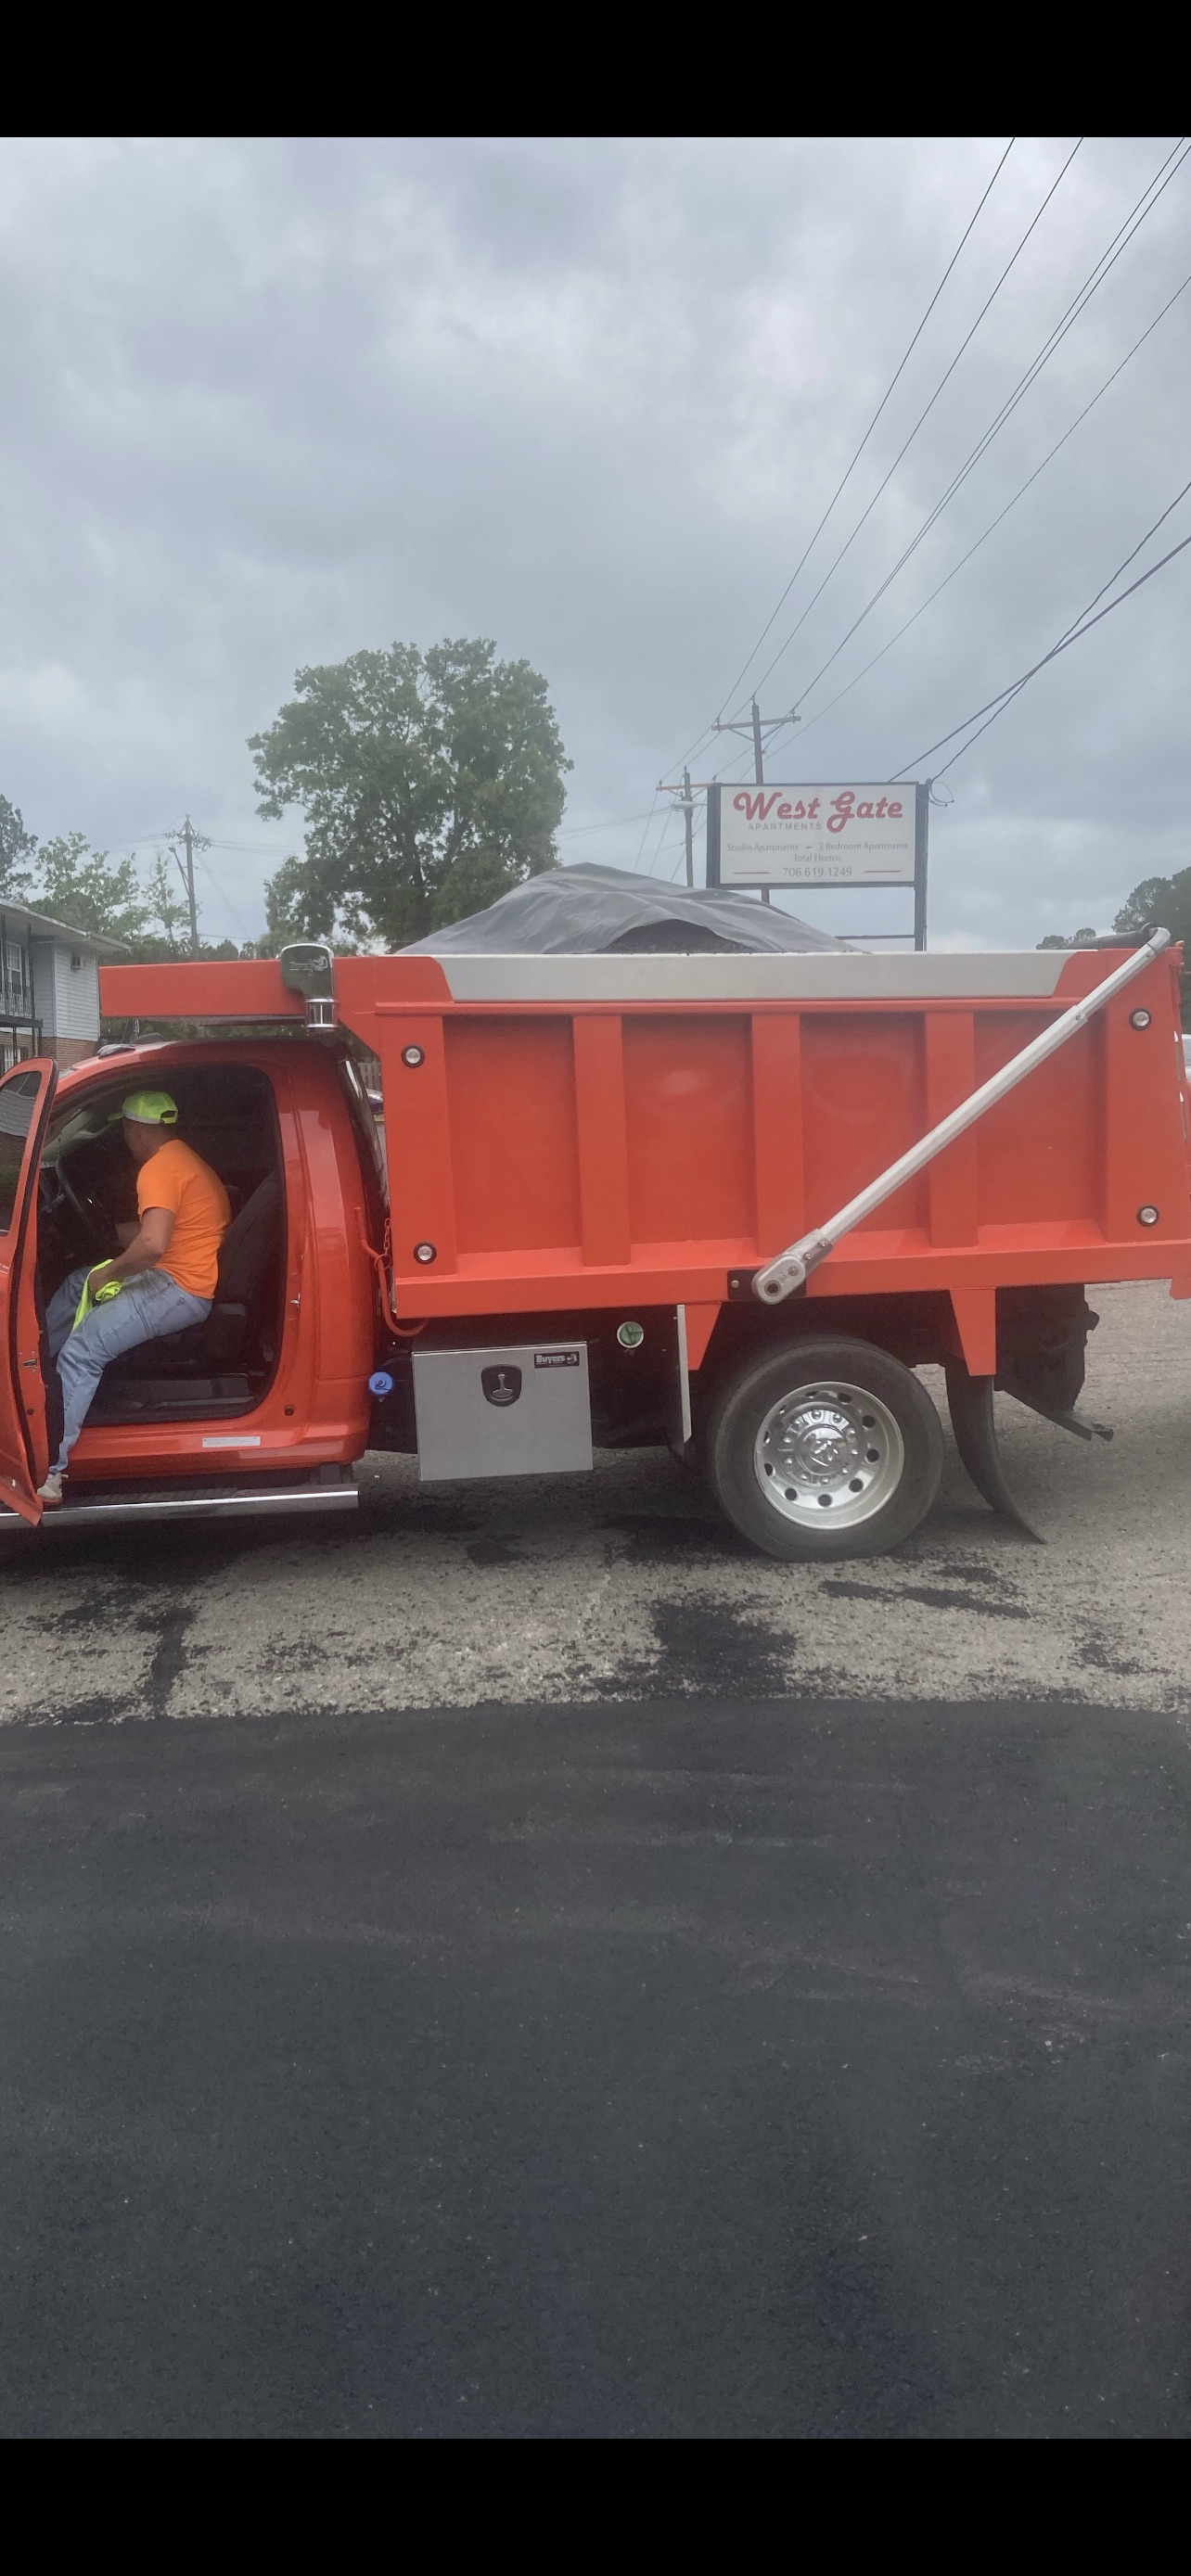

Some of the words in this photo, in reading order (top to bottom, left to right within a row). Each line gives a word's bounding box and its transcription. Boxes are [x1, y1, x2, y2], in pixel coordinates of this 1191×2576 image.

[733, 792, 821, 821] West
[826, 791, 903, 834] Gate
[748, 823, 822, 831] APARTMENTS
[727, 843, 752, 851] Studio
[754, 843, 799, 852] Apartments
[818, 842, 824, 850] 2
[826, 842, 861, 850] Bedroom
[863, 842, 908, 852] Apartments
[794, 853, 812, 862] Total
[814, 853, 841, 862] Electric
[535, 1355, 566, 1364] Buyers
